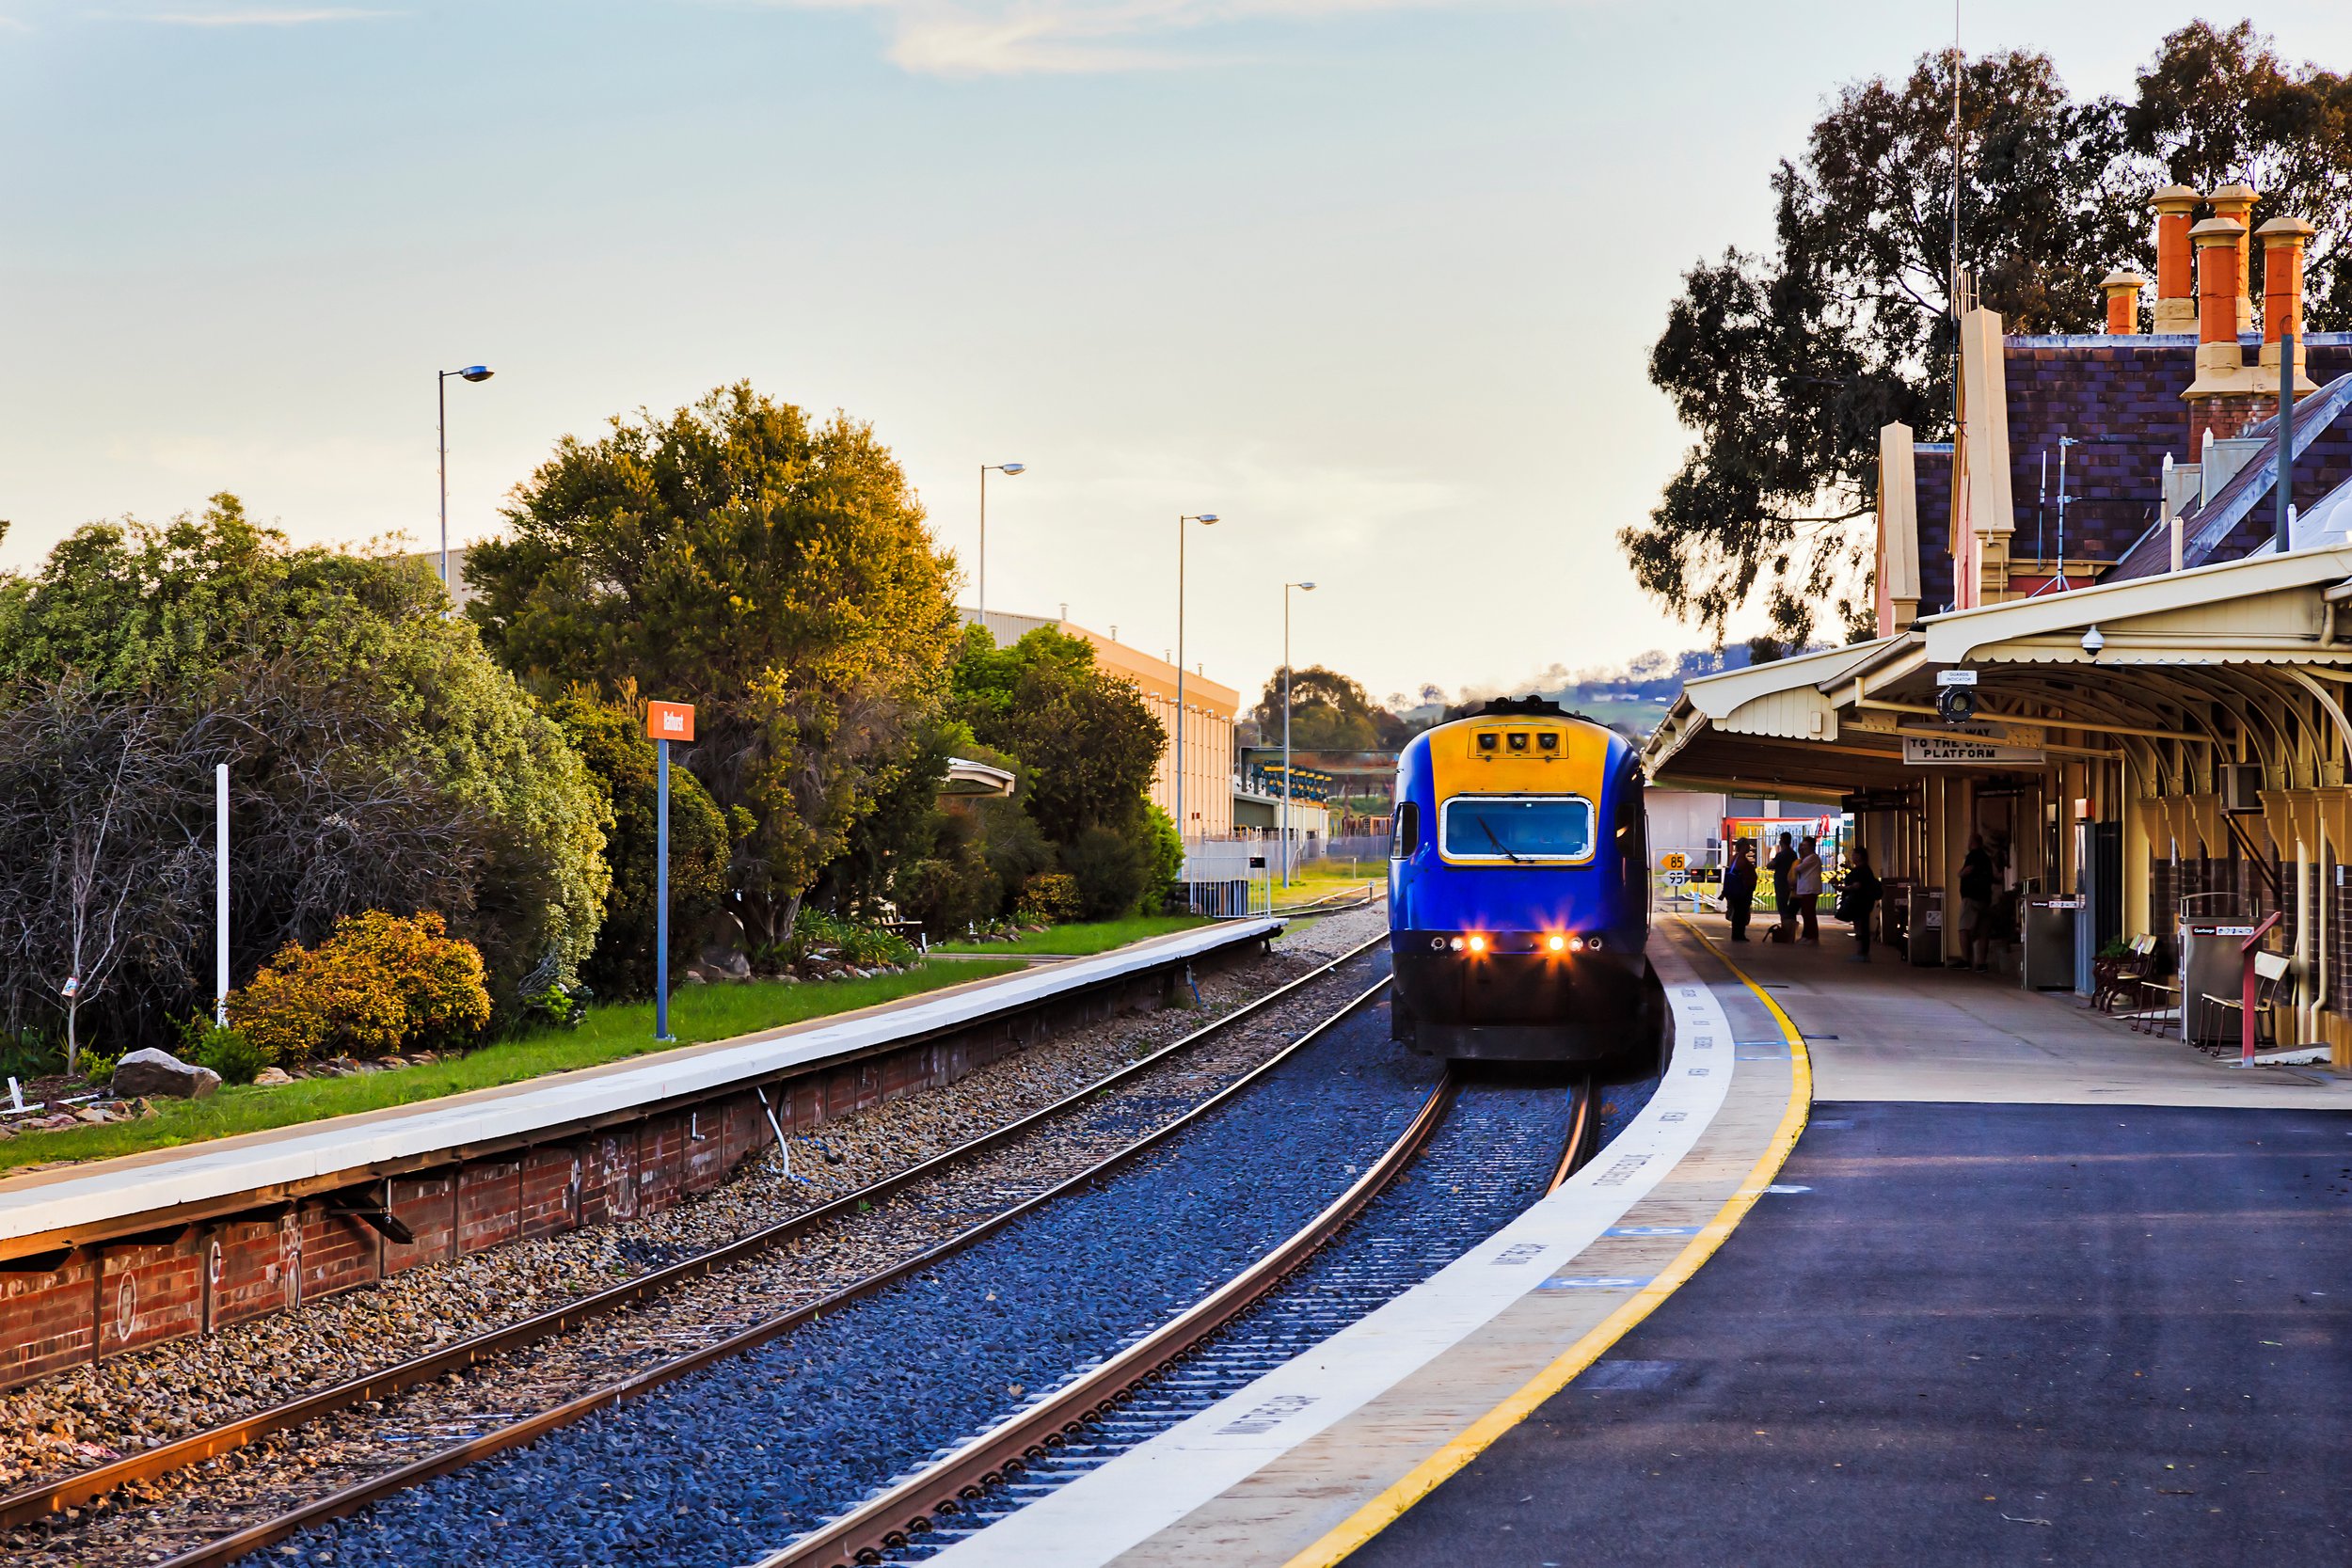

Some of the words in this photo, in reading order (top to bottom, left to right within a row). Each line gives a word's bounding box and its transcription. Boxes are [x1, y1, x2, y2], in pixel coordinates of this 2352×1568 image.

[1911, 739, 1928, 748] TO
[1933, 739, 1960, 748] THE
[1924, 750, 1995, 758] PLATFORM
[1671, 857, 1683, 868] 85
[1670, 872, 1684, 884] 95
